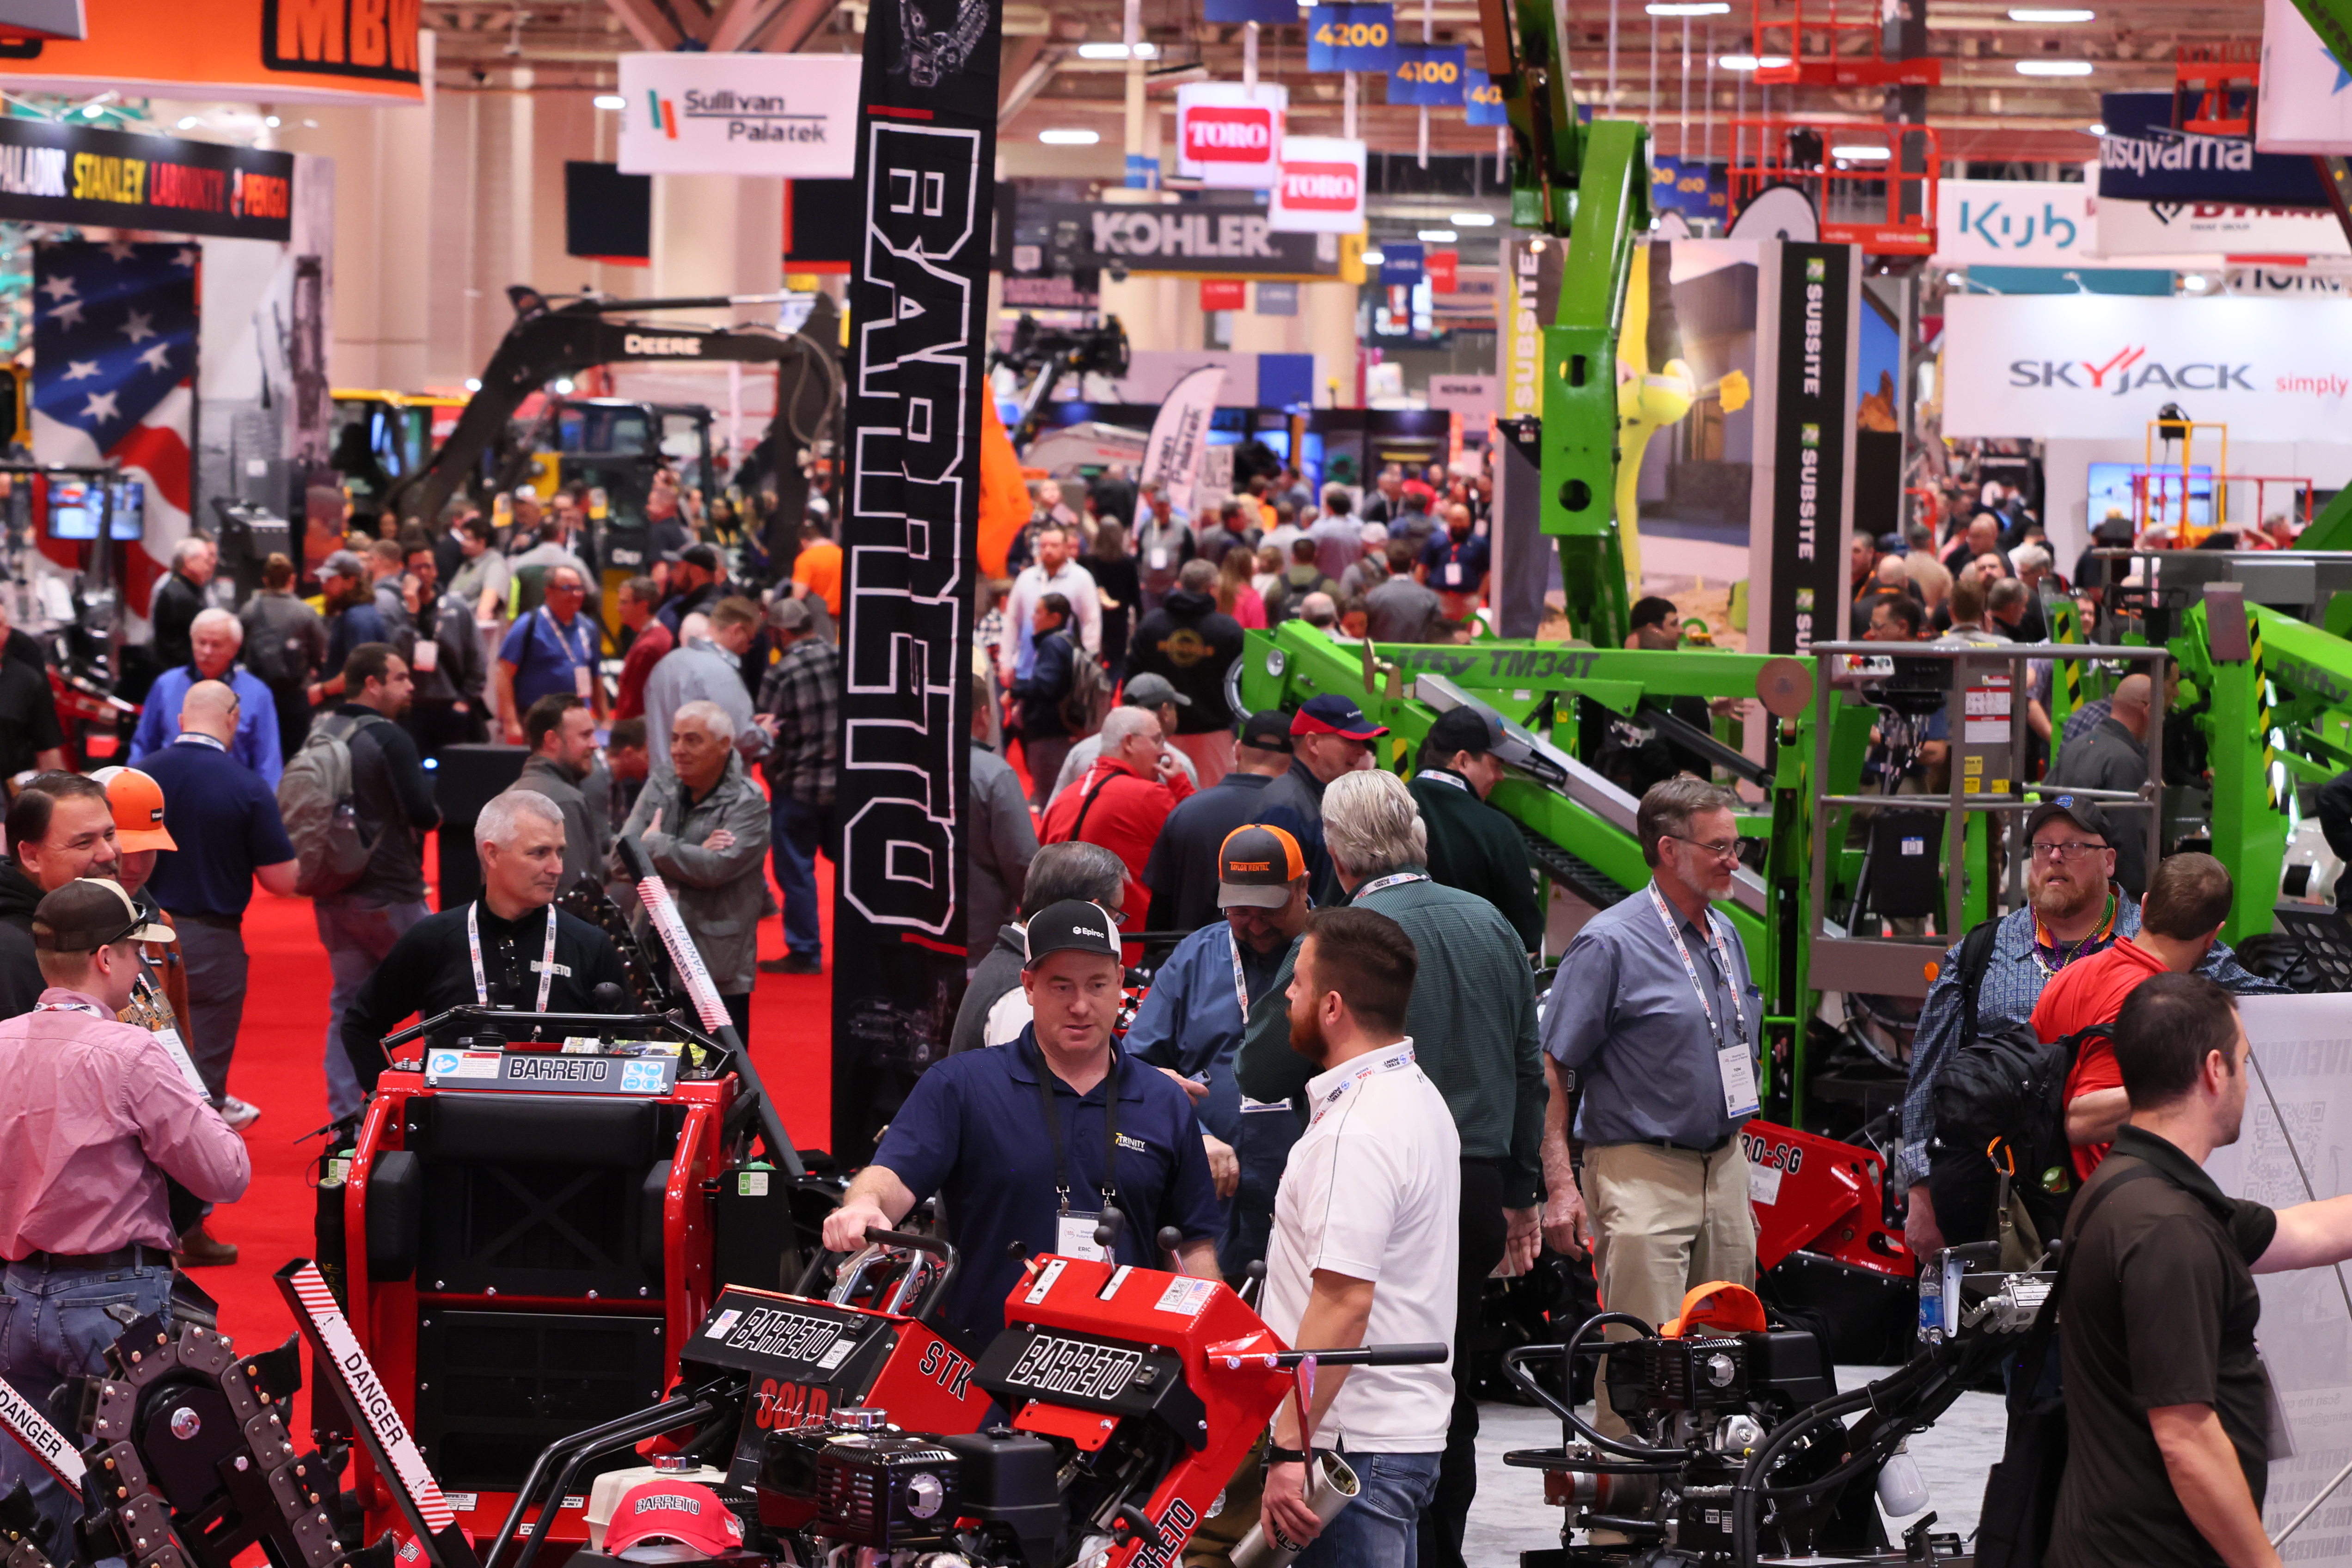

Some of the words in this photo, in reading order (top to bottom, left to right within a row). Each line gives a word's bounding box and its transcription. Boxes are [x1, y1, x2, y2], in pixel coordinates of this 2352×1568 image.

[1315, 24, 1388, 46] 4200
[1396, 61, 1458, 83] 4100
[684, 90, 784, 112] Sullivan
[728, 120, 827, 143] Palatek
[1188, 122, 1268, 148] TORO
[73, 151, 147, 205] STANLEY
[1285, 173, 1356, 199] TORO
[625, 335, 702, 355] DEERE
[1514, 247, 1539, 408] SUBSITE
[1803, 283, 1825, 397] SUBSITE
[2008, 344, 2256, 395] SKYJACK
[2276, 374, 2348, 398] simply
[1798, 448, 1819, 561] SUBSITE
[844, 121, 980, 935] BARRETO
[1490, 650, 1600, 679] TM34T
[2276, 659, 2350, 703] nifty
[1230, 862, 1247, 872] TAYLOR
[1248, 863, 1270, 872] RENTAL
[675, 925, 706, 975] DANGER
[1082, 927, 1105, 938] Epiroc
[663, 928, 693, 982] DANGER
[508, 1057, 609, 1083] BARRETO
[1357, 1070, 1372, 1079] ARA
[1118, 1135, 1145, 1149] TRINITY
[725, 1307, 844, 1362] BARRETO
[919, 1340, 974, 1402] STK
[1006, 1334, 1142, 1401] BARRETO
[343, 1352, 404, 1447] DANGER
[753, 1392, 803, 1417] Thank
[756, 1378, 828, 1429] SOLD
[0, 1389, 62, 1460] DANGER
[635, 1494, 701, 1516] BARRETO
